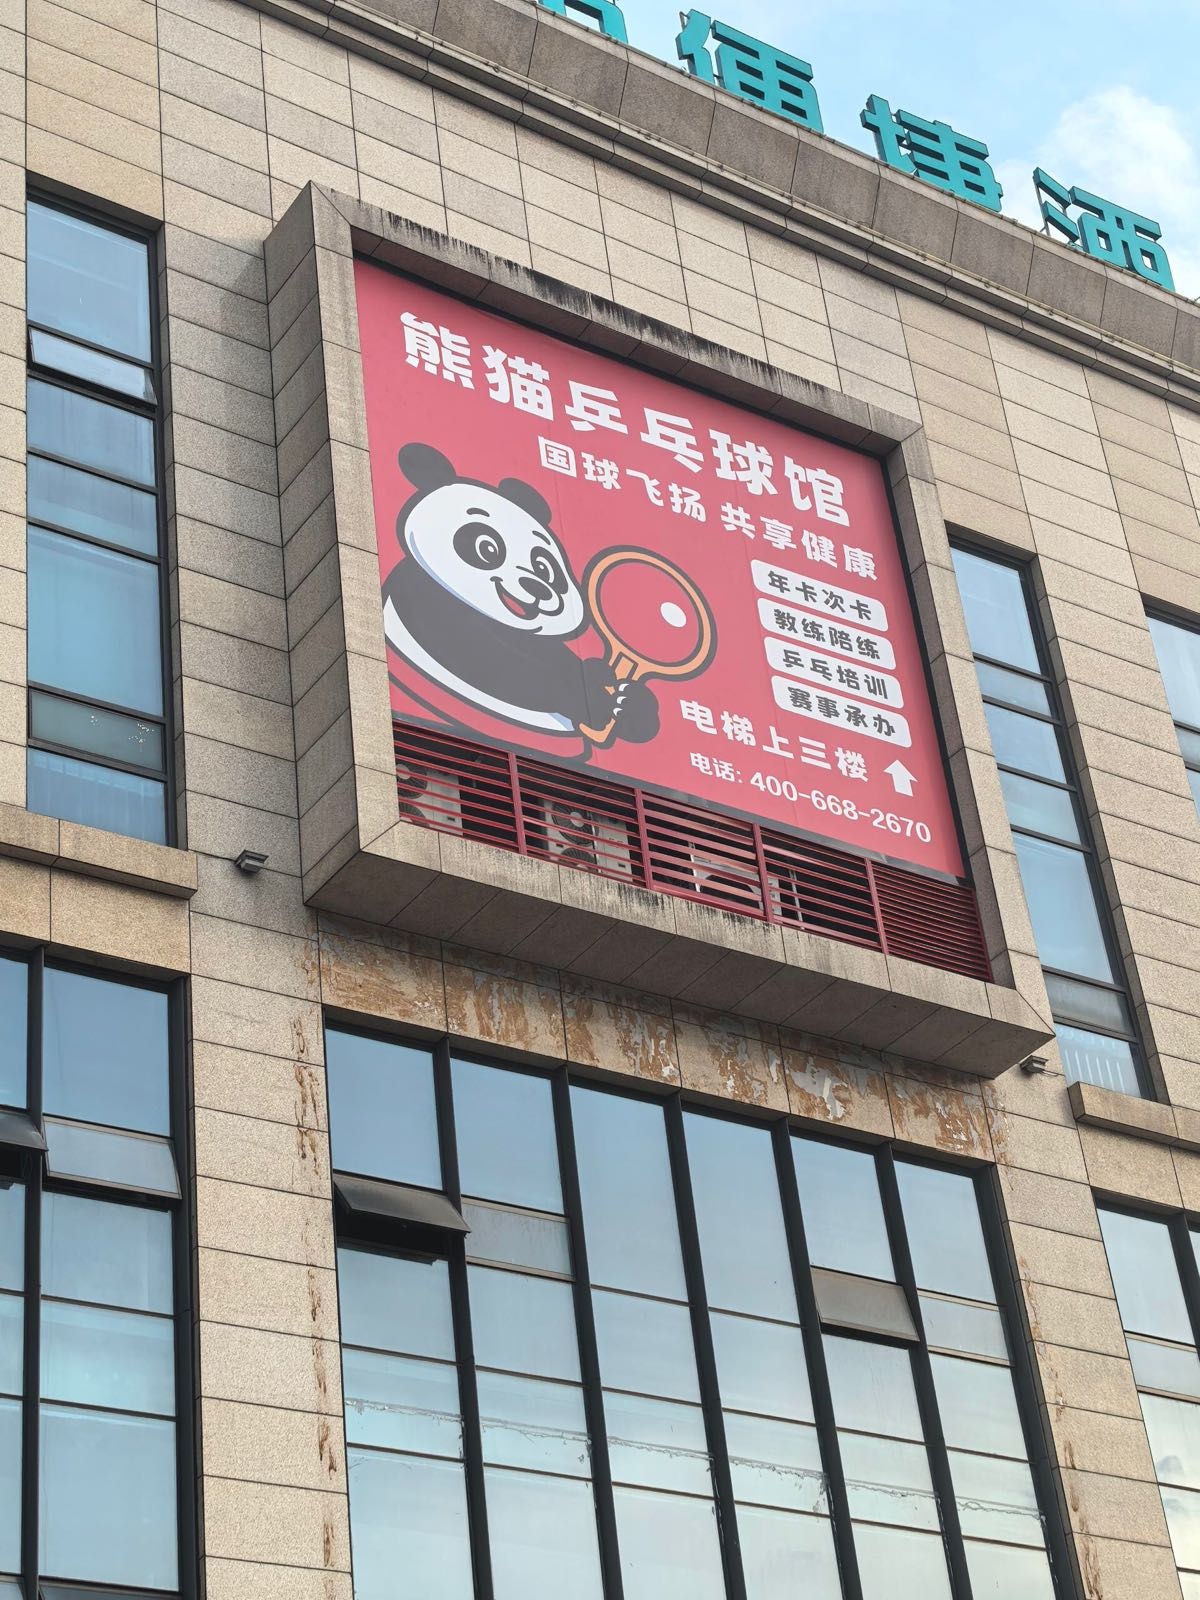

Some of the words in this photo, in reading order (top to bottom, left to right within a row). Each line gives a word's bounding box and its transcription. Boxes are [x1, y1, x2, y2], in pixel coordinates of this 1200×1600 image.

[400, 312, 850, 527] 熊猫乒乓球馆
[538, 436, 706, 523] 国球飞扬
[720, 502, 878, 581] 共享健康
[767, 570, 872, 621] 年卡次卡
[774, 608, 881, 660] 教练陪练
[782, 649, 889, 700] 乒乓培训
[680, 700, 869, 783] 电梯上三楼
[787, 686, 896, 737] 赛事承办
[750, 772, 932, 843] 400-668-2670
